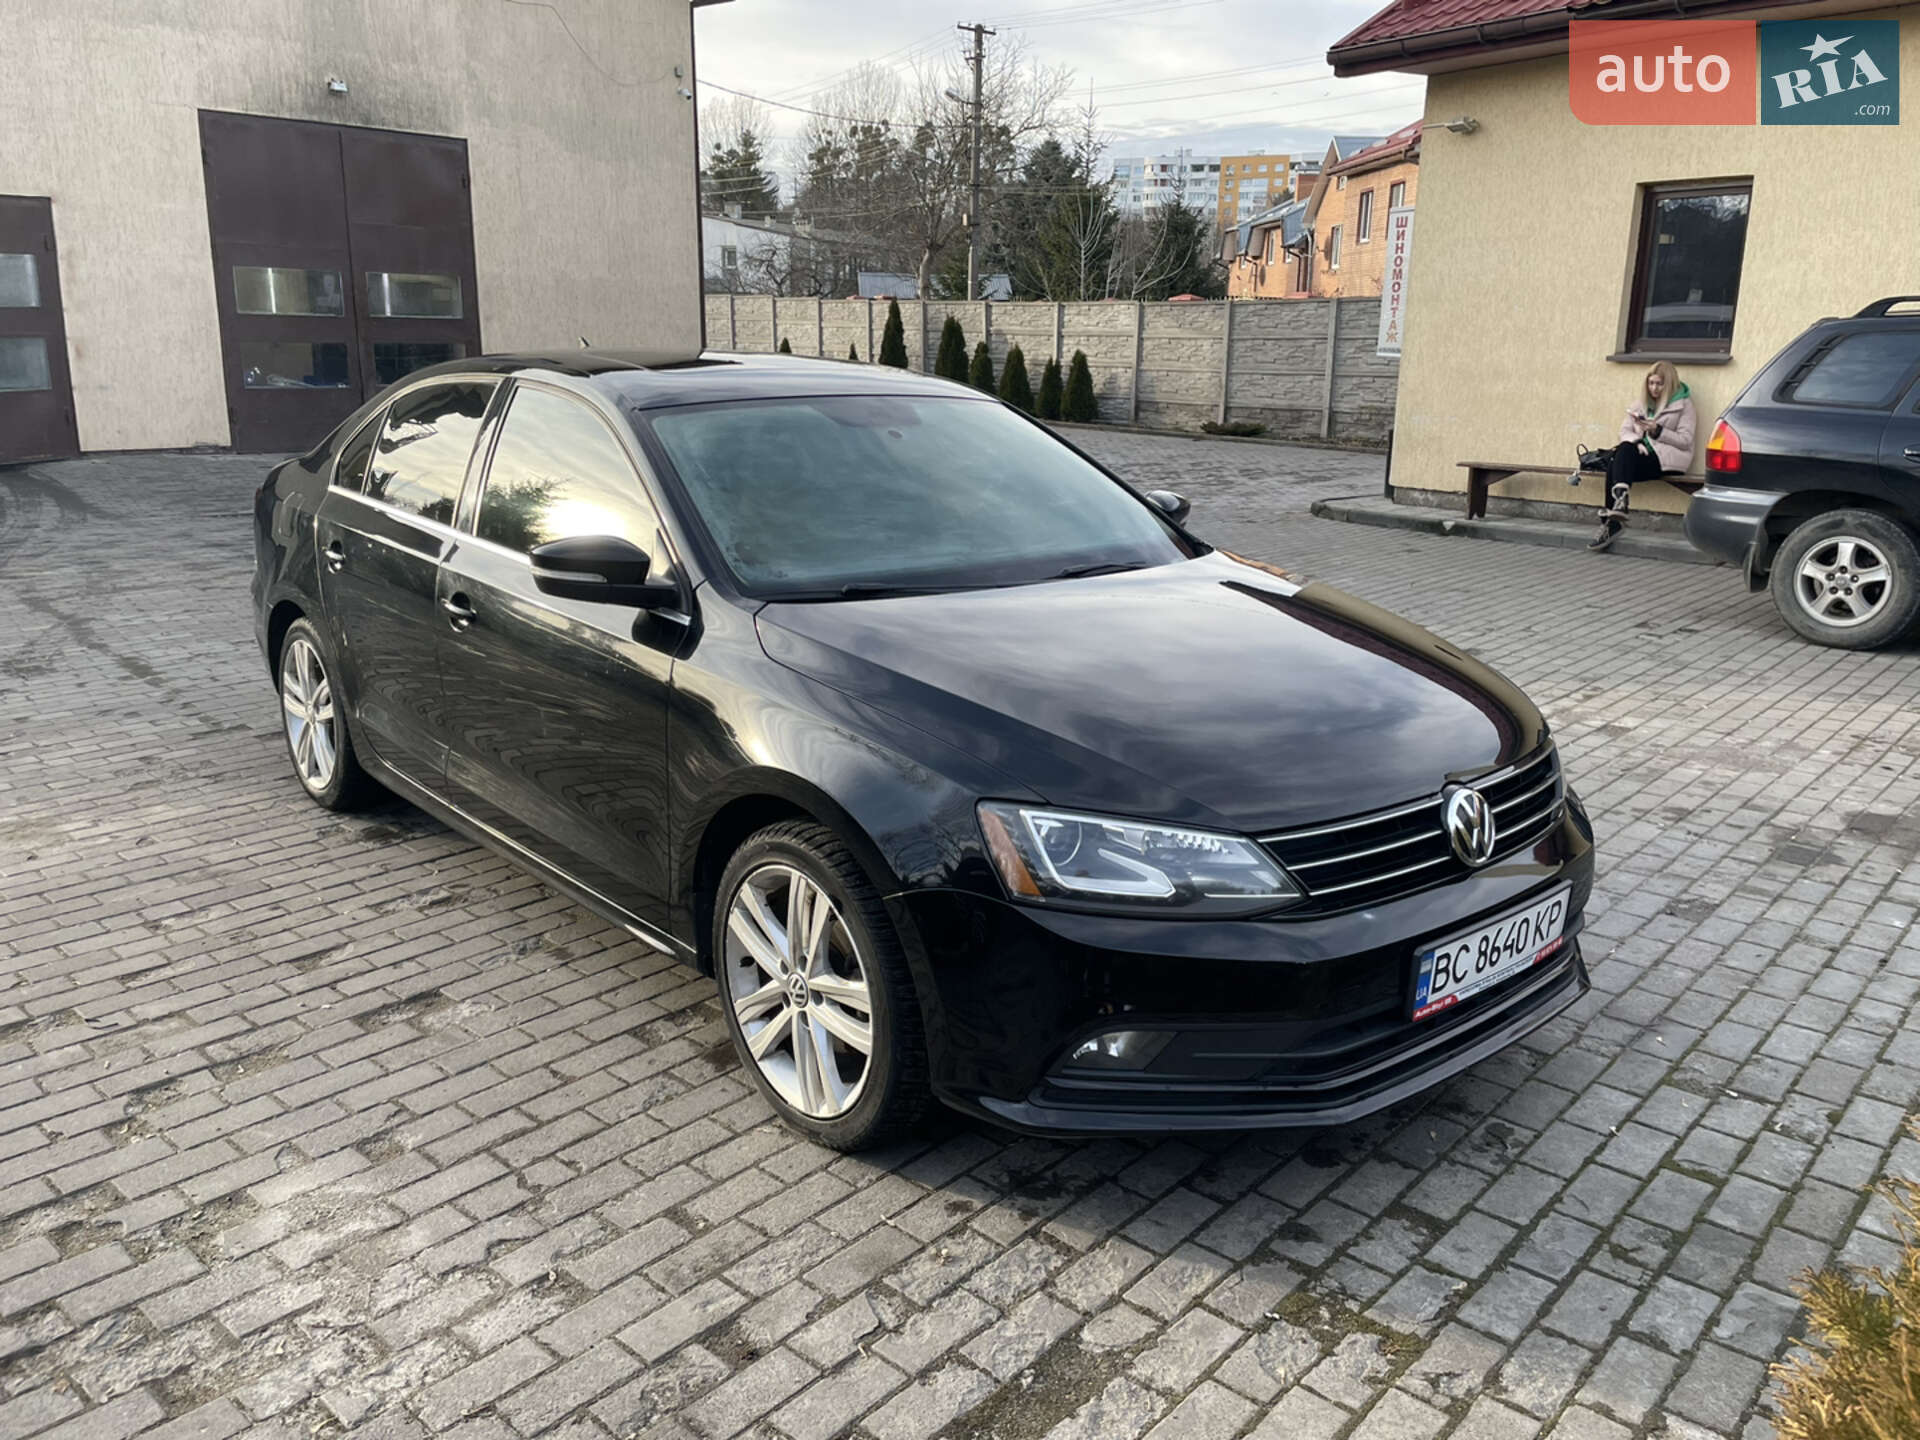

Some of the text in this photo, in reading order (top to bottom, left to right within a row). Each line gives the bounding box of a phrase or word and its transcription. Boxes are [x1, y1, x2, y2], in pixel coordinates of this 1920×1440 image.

[1385, 215, 1409, 343] ШИНОМОНТАЖ
[1431, 943, 1471, 995] BC
[1475, 917, 1530, 974] 8640
[1532, 899, 1562, 947] KP
